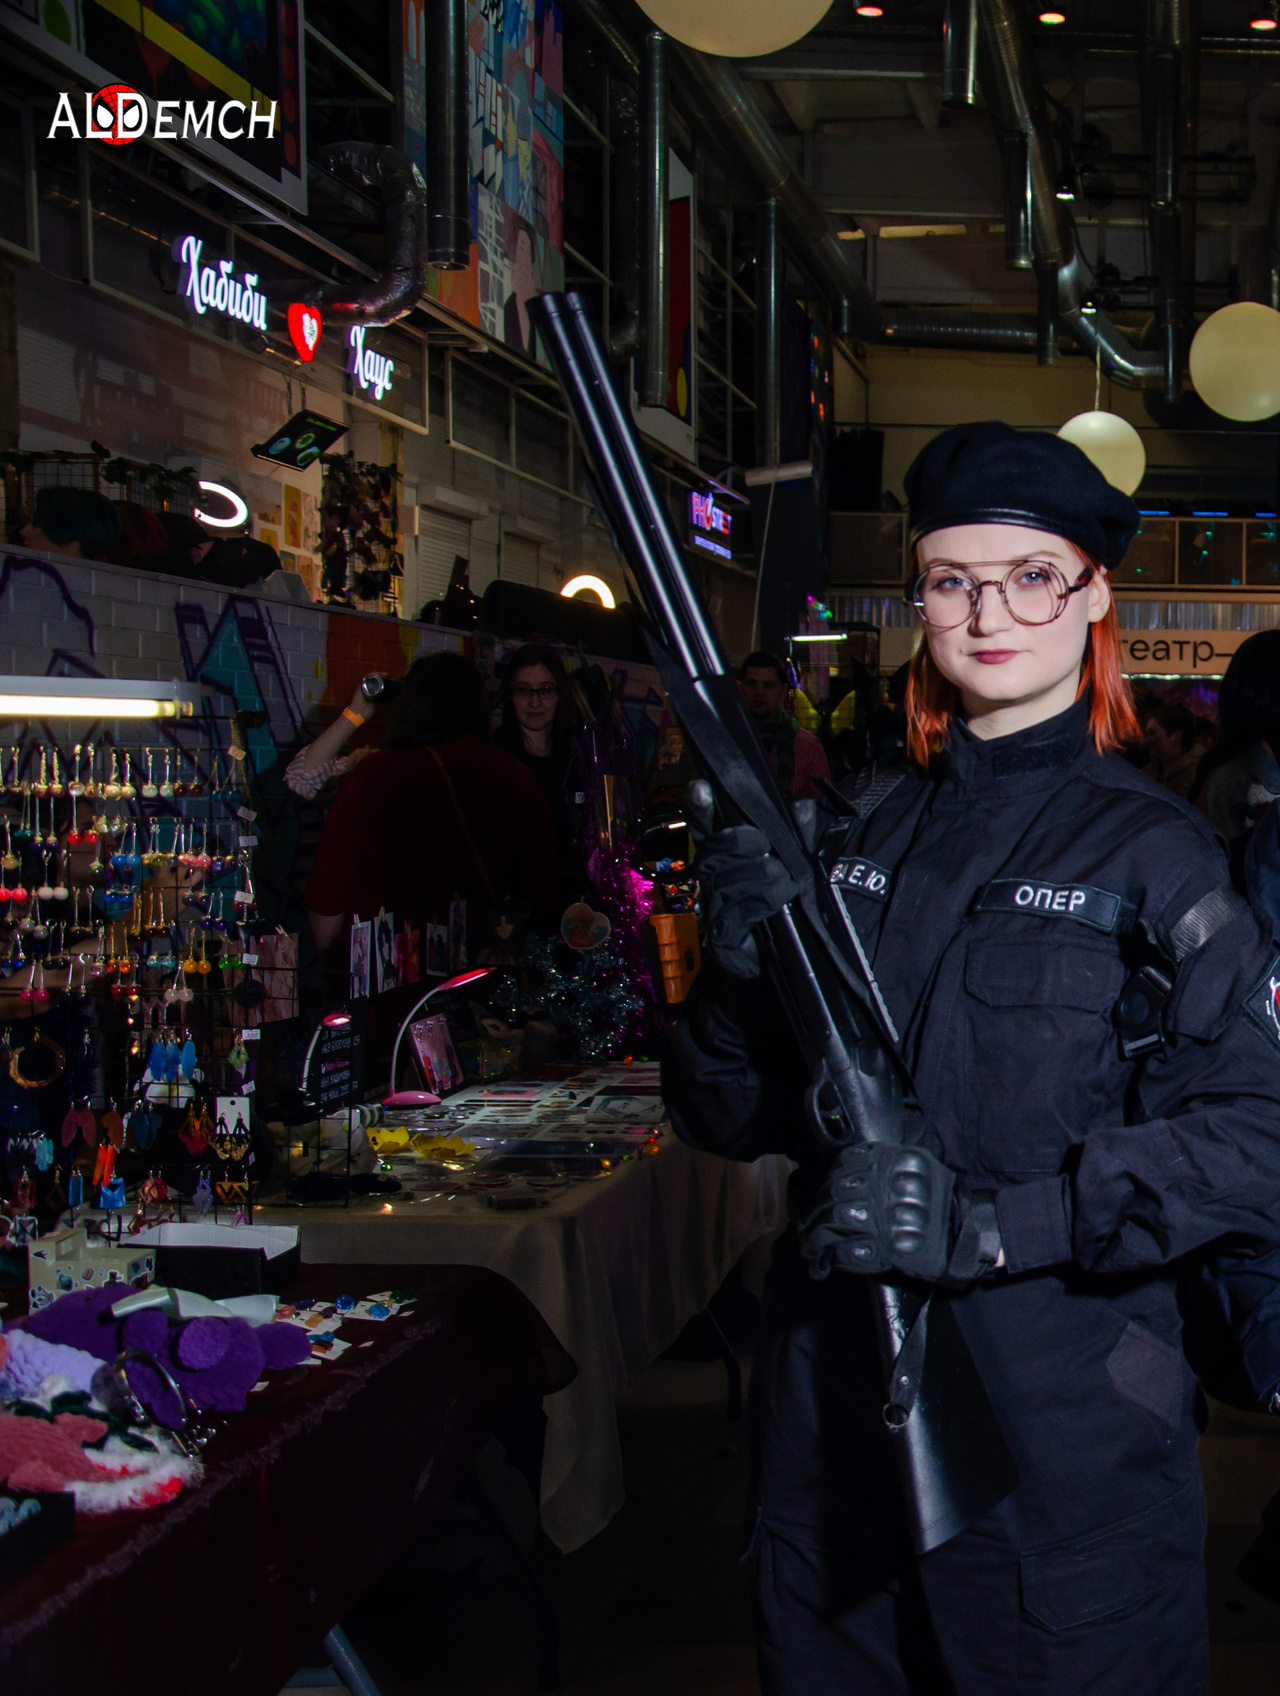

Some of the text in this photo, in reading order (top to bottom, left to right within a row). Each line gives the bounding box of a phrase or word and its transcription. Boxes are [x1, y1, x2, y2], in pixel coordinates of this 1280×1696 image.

[181, 235, 268, 331] Хабиби
[350, 325, 395, 400] Хаус
[1014, 884, 1087, 913] ОПЕР
